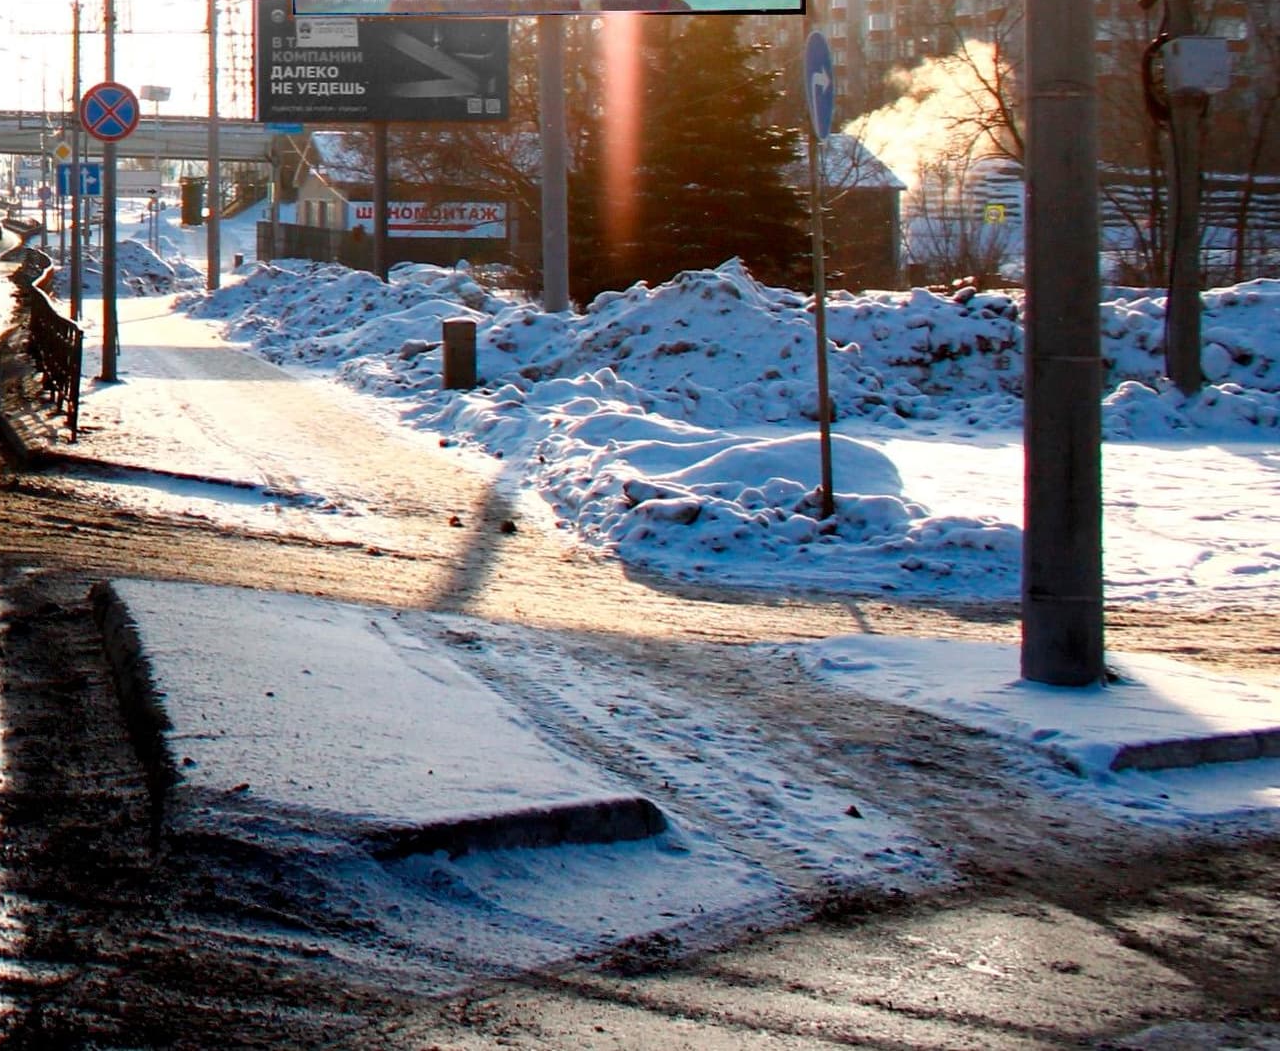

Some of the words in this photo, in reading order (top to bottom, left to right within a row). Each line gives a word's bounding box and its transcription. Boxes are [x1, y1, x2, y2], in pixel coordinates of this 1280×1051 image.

[271, 51, 364, 64] КОМПАНИИ
[270, 65, 339, 81] ДАЛЕКО
[271, 82, 293, 95] НЕ
[297, 81, 366, 97] УЕДЕШЬ
[355, 206, 498, 221] ШНОМОНТАЖ
